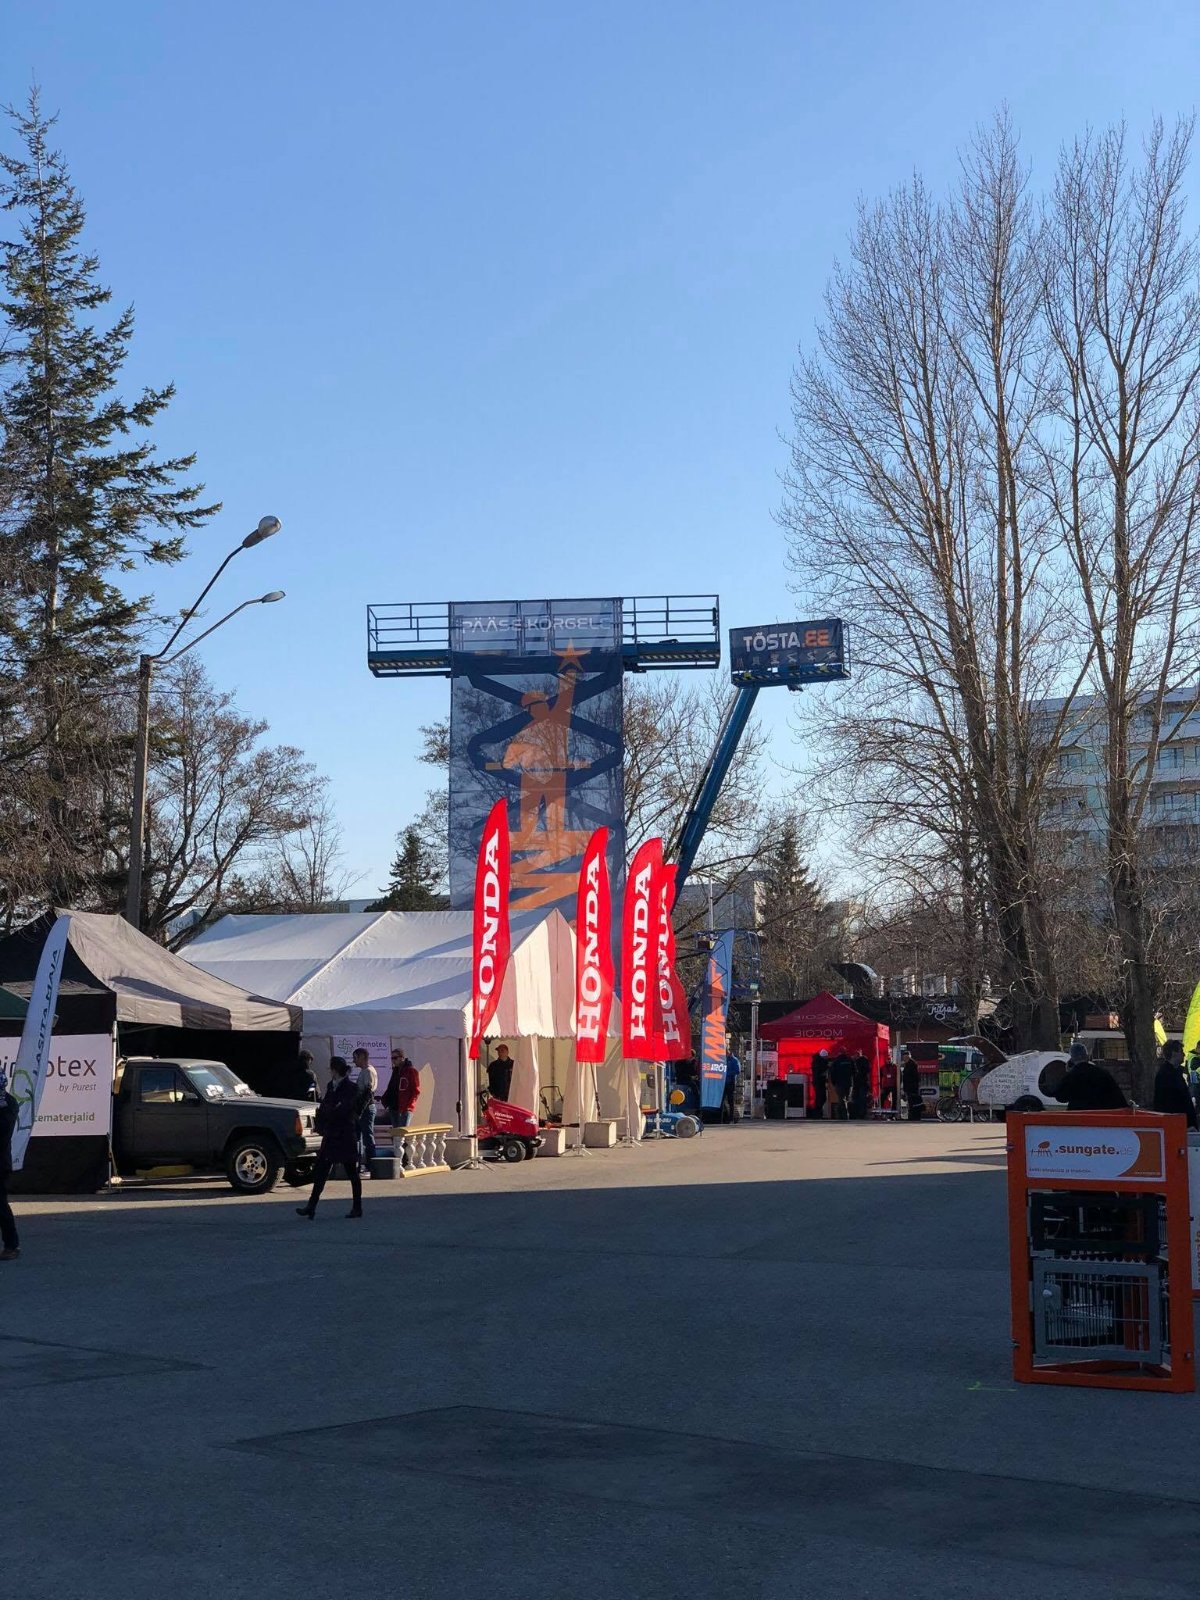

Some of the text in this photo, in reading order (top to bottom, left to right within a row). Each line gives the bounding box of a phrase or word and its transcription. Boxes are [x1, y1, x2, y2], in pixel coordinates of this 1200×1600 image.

[743, 628, 832, 652] TÕSTA.EE
[578, 853, 600, 1043] HONDA
[630, 862, 651, 1040] HONDA
[32, 1007, 48, 1077] LASITA
[59, 1082, 97, 1093] by Purest
